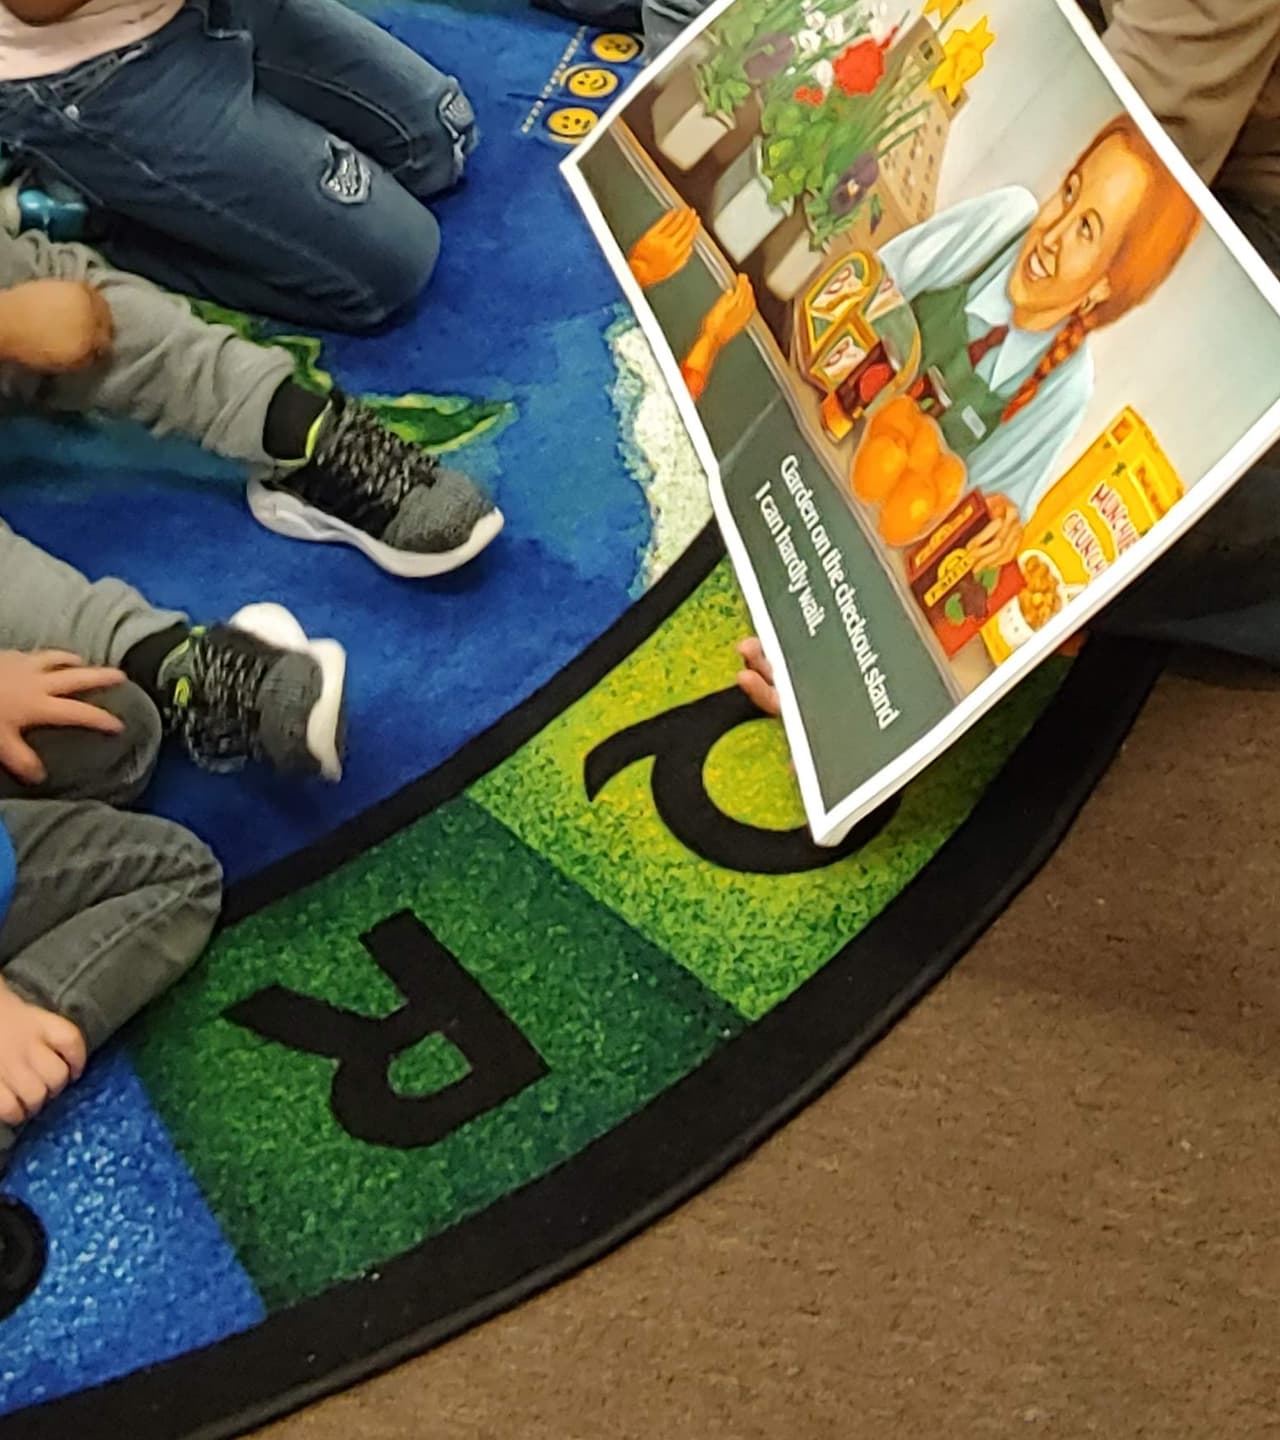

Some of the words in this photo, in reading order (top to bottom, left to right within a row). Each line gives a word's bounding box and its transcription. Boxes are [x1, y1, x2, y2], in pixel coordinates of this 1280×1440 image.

[754, 481, 771, 501] I
[761, 494, 783, 535] can
[781, 454, 822, 530] Garden
[776, 525, 809, 593] hardly
[811, 524, 832, 556] on
[822, 545, 847, 589] the
[799, 584, 826, 638] wait.
[834, 582, 880, 675] checkout
[863, 665, 901, 730] stand
[222, 908, 549, 1148] R
